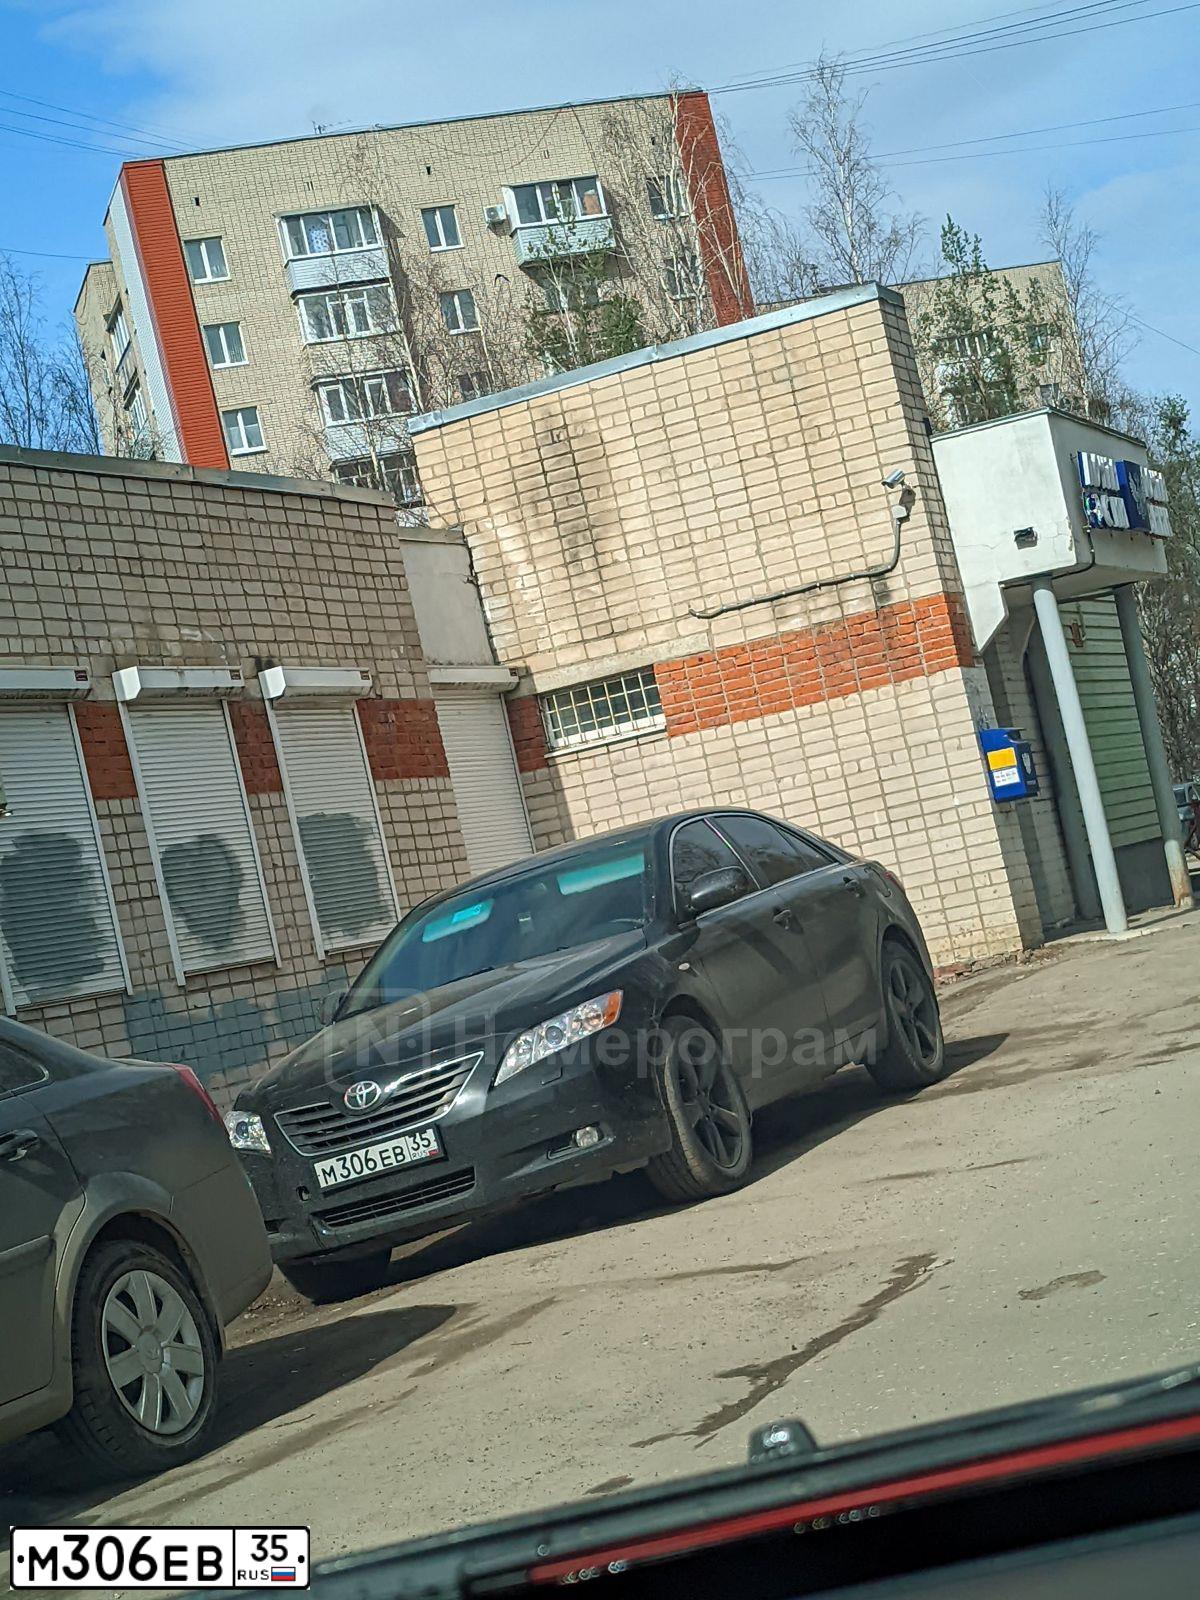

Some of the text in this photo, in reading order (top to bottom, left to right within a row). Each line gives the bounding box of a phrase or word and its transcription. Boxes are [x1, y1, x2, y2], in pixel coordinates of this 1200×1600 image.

[321, 1132, 431, 1185] М306ЕВ 35
[412, 1149, 428, 1159] RUS
